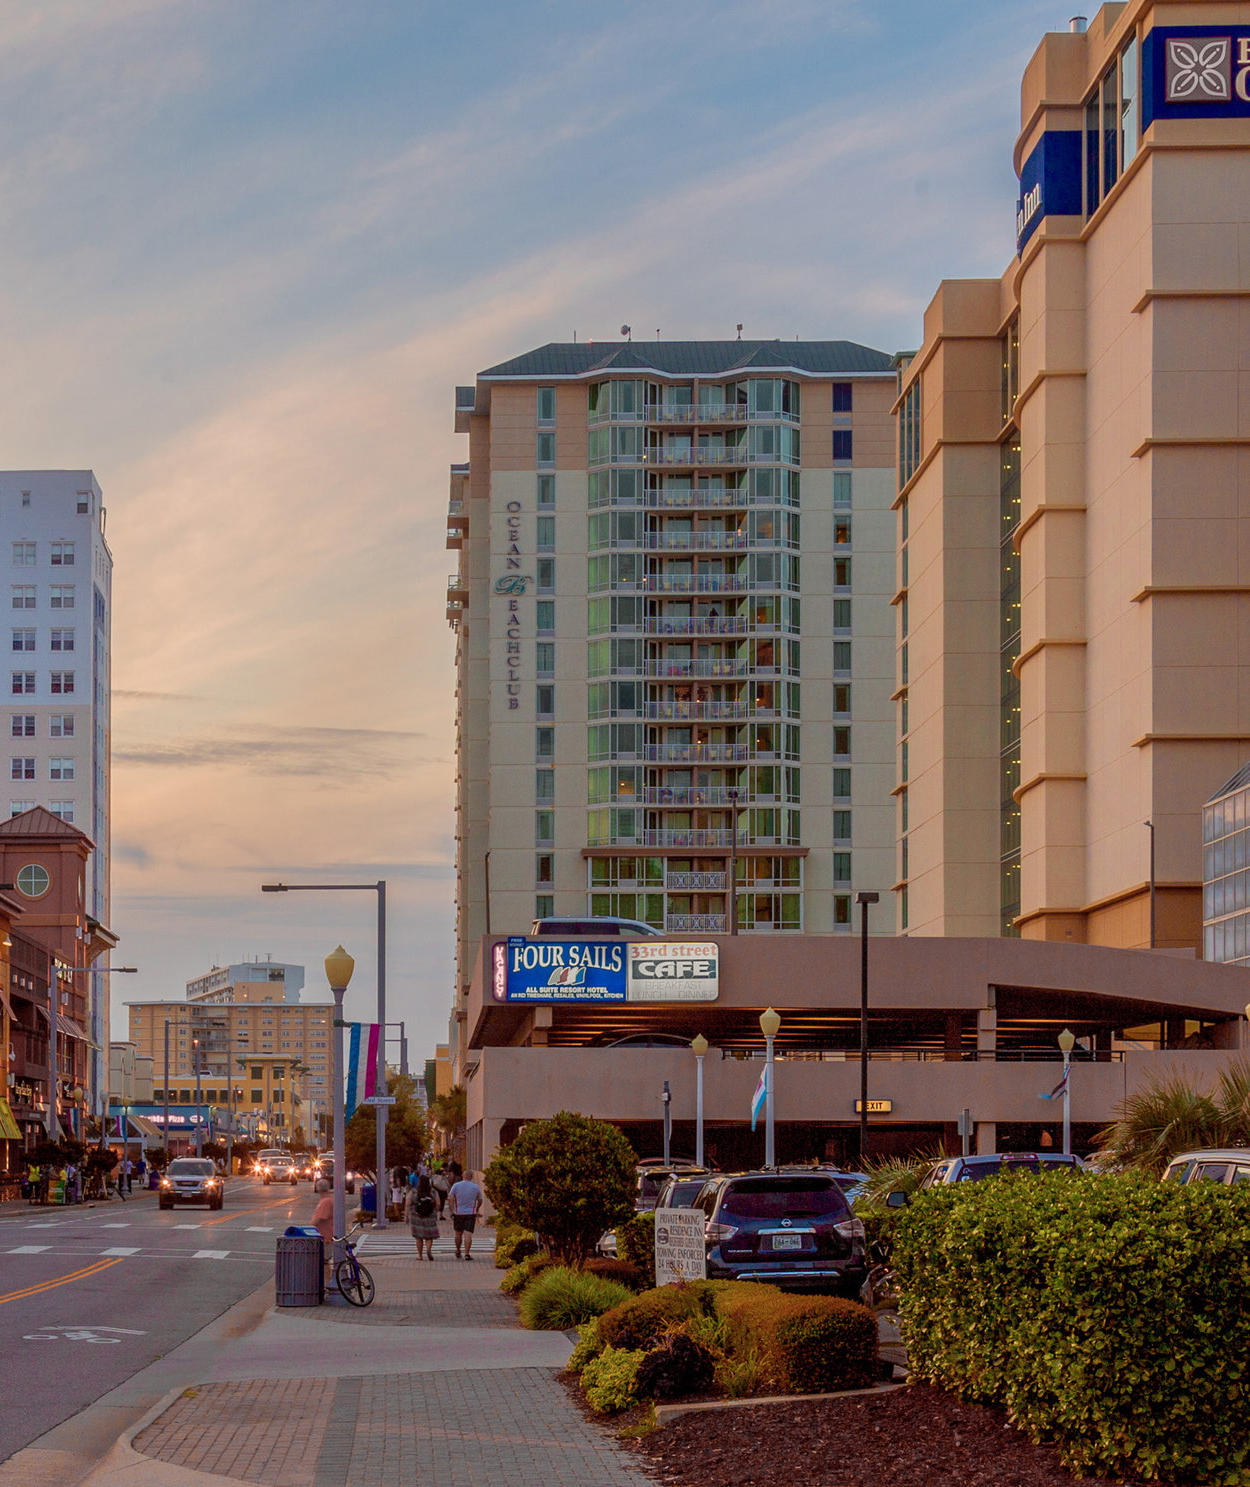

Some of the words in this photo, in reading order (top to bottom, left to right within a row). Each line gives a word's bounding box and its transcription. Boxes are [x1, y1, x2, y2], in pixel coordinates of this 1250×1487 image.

[1024, 183, 1039, 226] Inn
[506, 501, 521, 569] OCEAN
[631, 944, 667, 959] 33rd
[671, 945, 717, 957] street
[513, 945, 565, 972] FOUR
[568, 945, 622, 972] SAILS
[495, 946, 505, 998] VACANCY
[637, 960, 712, 978] CAFE
[645, 981, 703, 990] BREAKFAST
[632, 991, 667, 1000] LUNCH
[678, 990, 716, 999] DINNER
[866, 1102, 883, 1110] EXIT
[660, 1214, 678, 1224] PRIVATE
[678, 1214, 700, 1225] PARKING
[670, 1226, 693, 1236] RESIDENCE
[694, 1227, 703, 1237] INN
[657, 1247, 676, 1258] TOWING
[678, 1248, 704, 1260] ENFORCED
[692, 1261, 703, 1272] DAY
